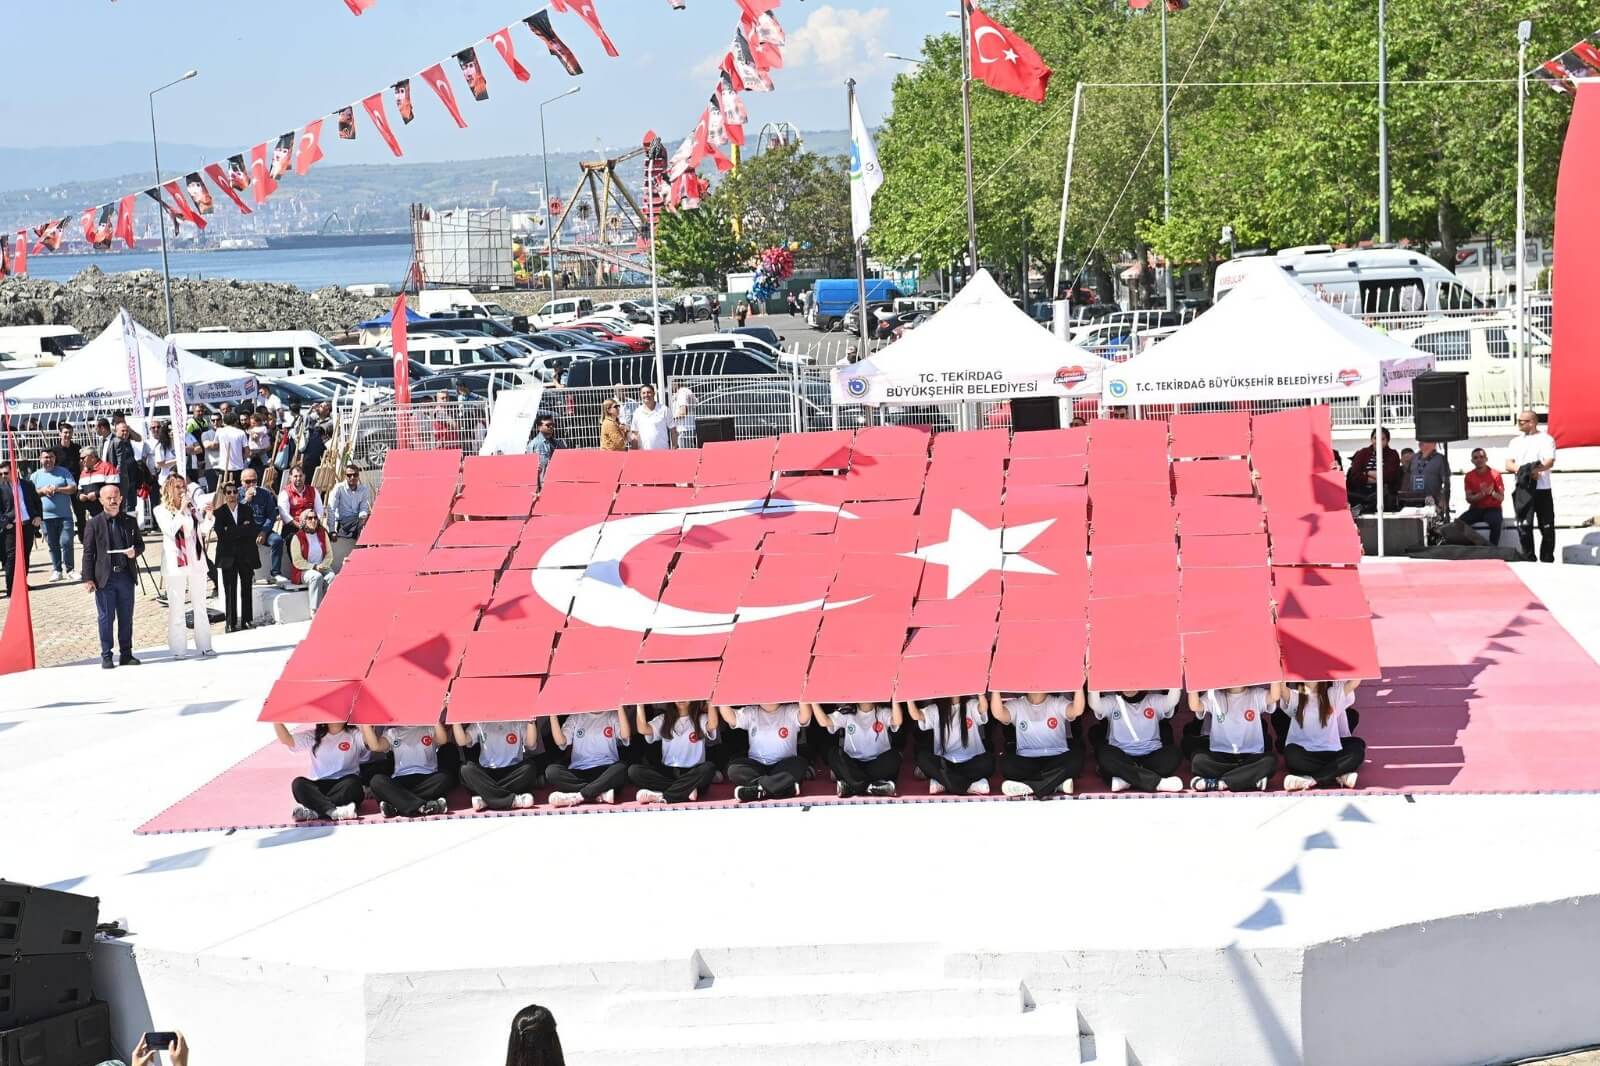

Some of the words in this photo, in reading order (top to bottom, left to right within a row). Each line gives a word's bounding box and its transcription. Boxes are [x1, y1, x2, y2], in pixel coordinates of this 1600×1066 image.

[886, 385, 964, 398] BÜYÜKŞEHİR
[967, 380, 1038, 395] BELEDİYESİ
[1136, 382, 1154, 392] T.C.
[1156, 378, 1206, 391] TEKİRDAĞ
[1209, 375, 1274, 390] BÜYÜKŞEHİR
[1277, 372, 1333, 386] BELEDİYESİ
